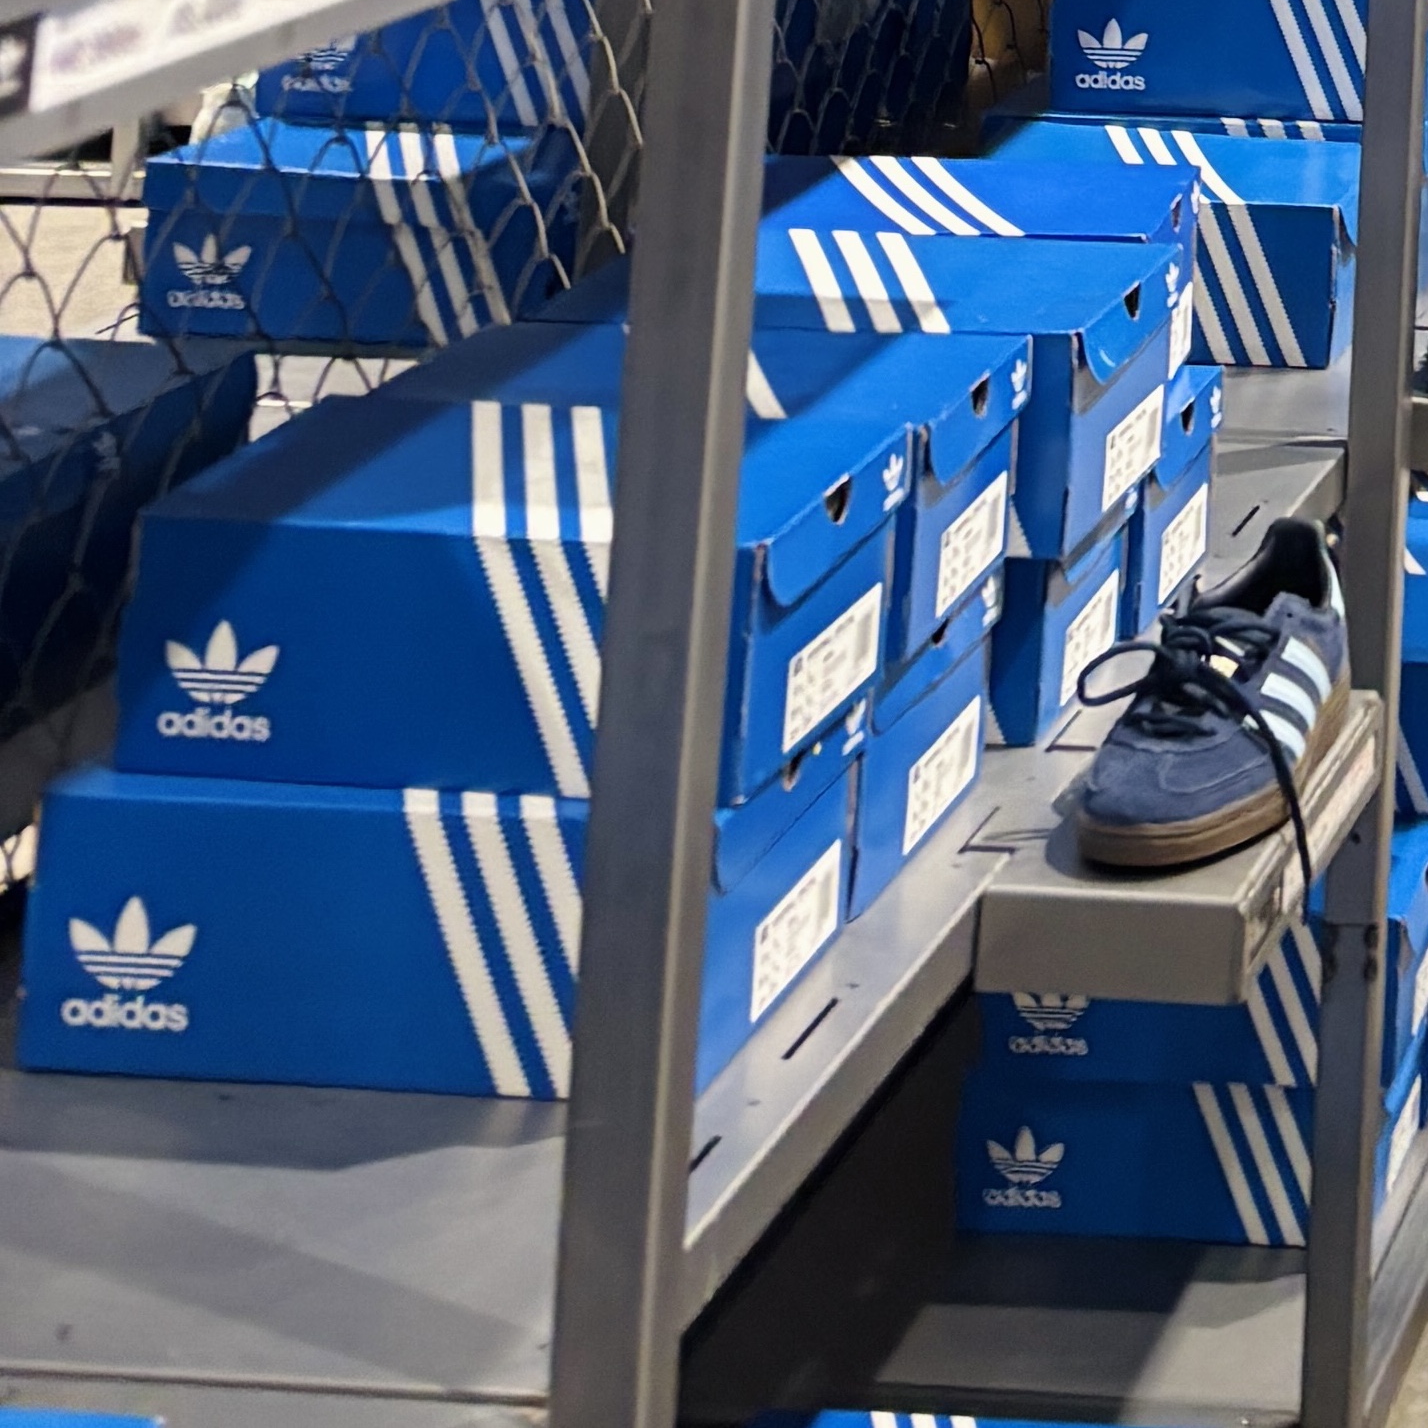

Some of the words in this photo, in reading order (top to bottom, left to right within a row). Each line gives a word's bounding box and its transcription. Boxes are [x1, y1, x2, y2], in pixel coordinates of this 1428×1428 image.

[1074, 70, 1146, 91] adidas
[156, 706, 271, 743] adidas
[60, 993, 189, 1032] adidas
